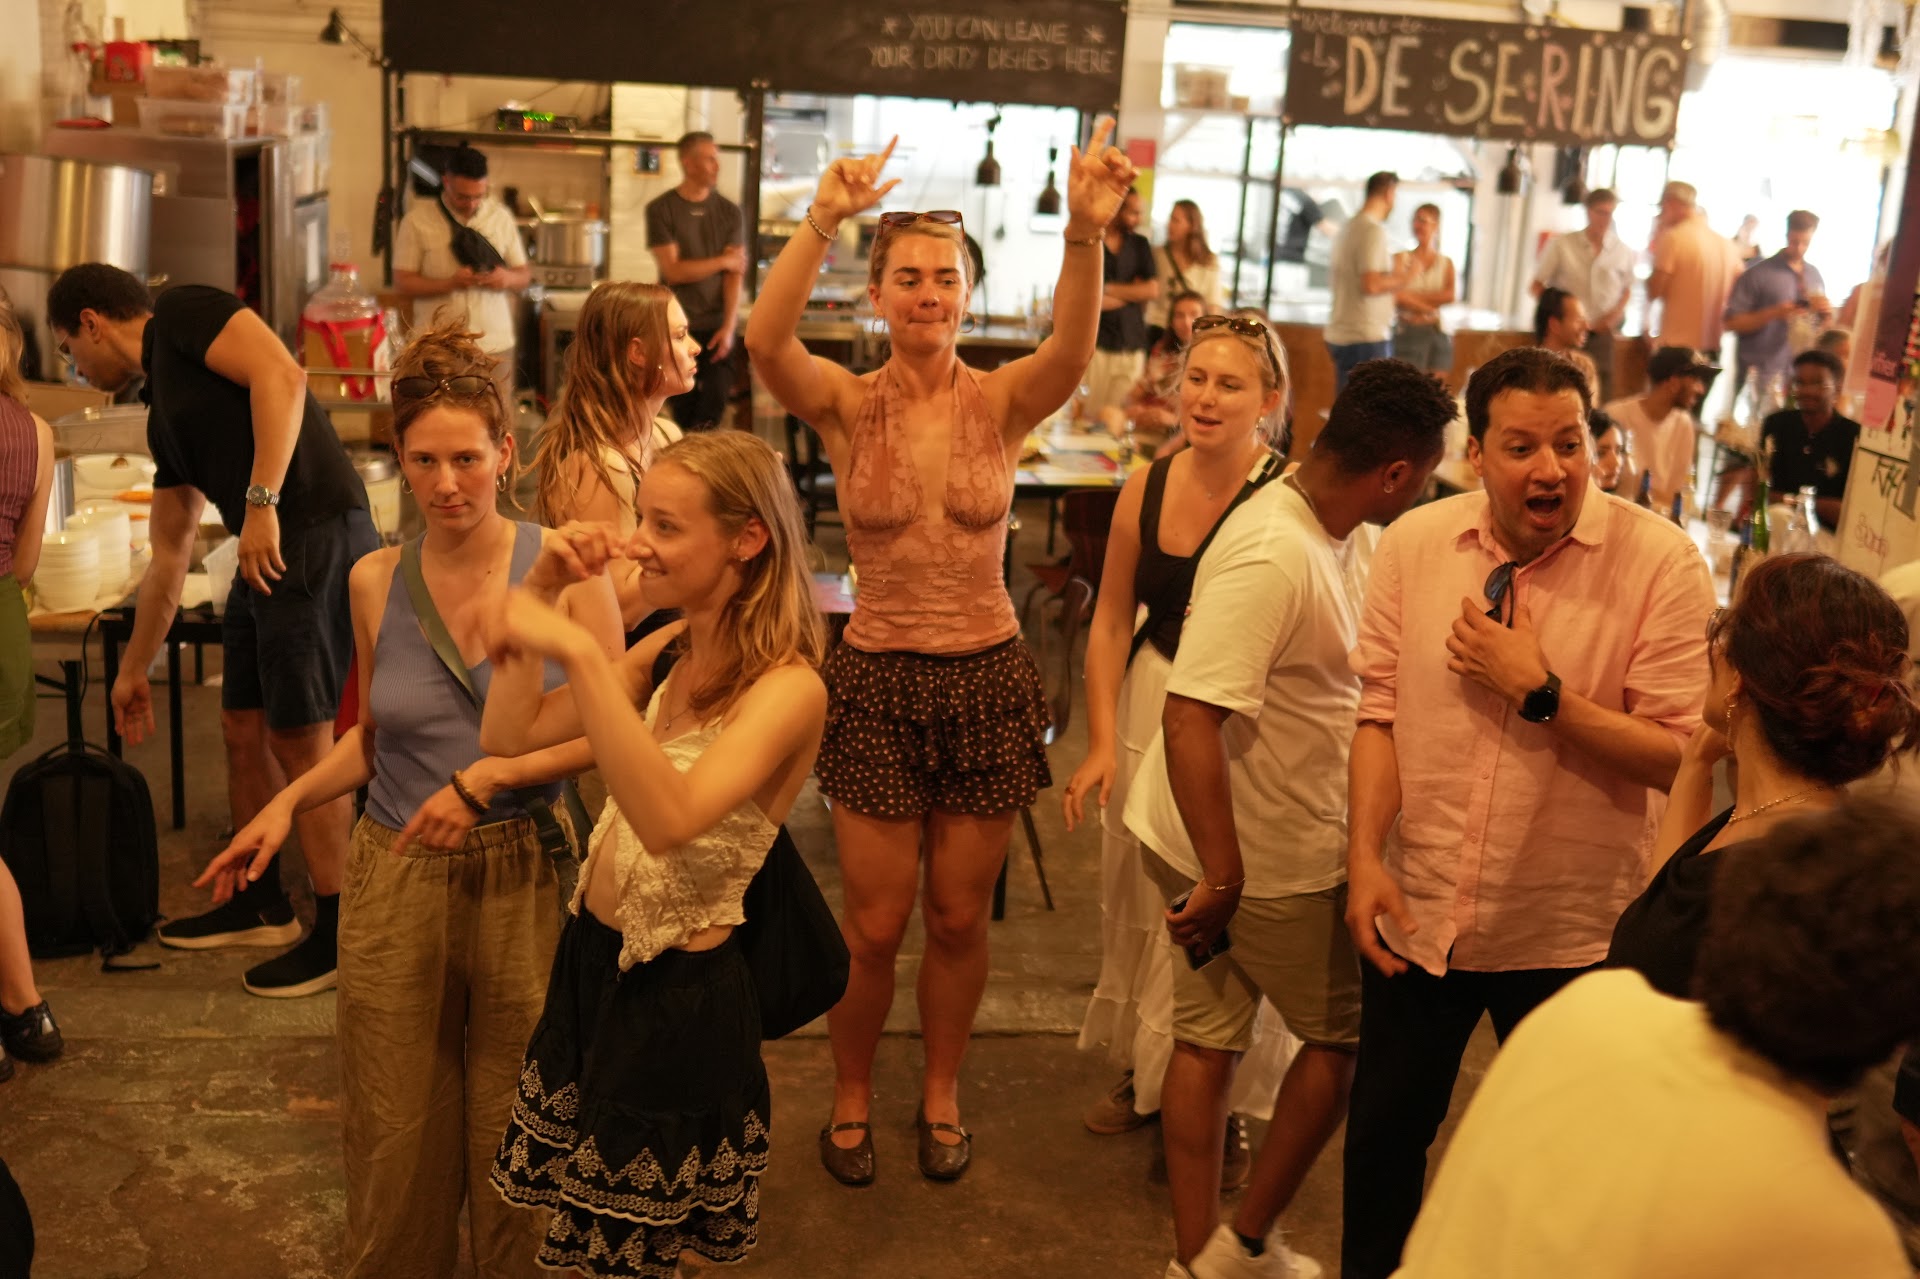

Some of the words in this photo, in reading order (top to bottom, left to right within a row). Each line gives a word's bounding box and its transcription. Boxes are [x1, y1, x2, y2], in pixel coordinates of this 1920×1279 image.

[908, 14, 950, 41] YOU
[956, 17, 999, 41] CAN
[1004, 19, 1069, 45] LEAVE
[870, 45, 914, 69] YOUR
[923, 46, 978, 72] DIRTY
[1065, 49, 1116, 74] HERE
[1343, 35, 1422, 117] DE
[1443, 39, 1680, 139] SERING
